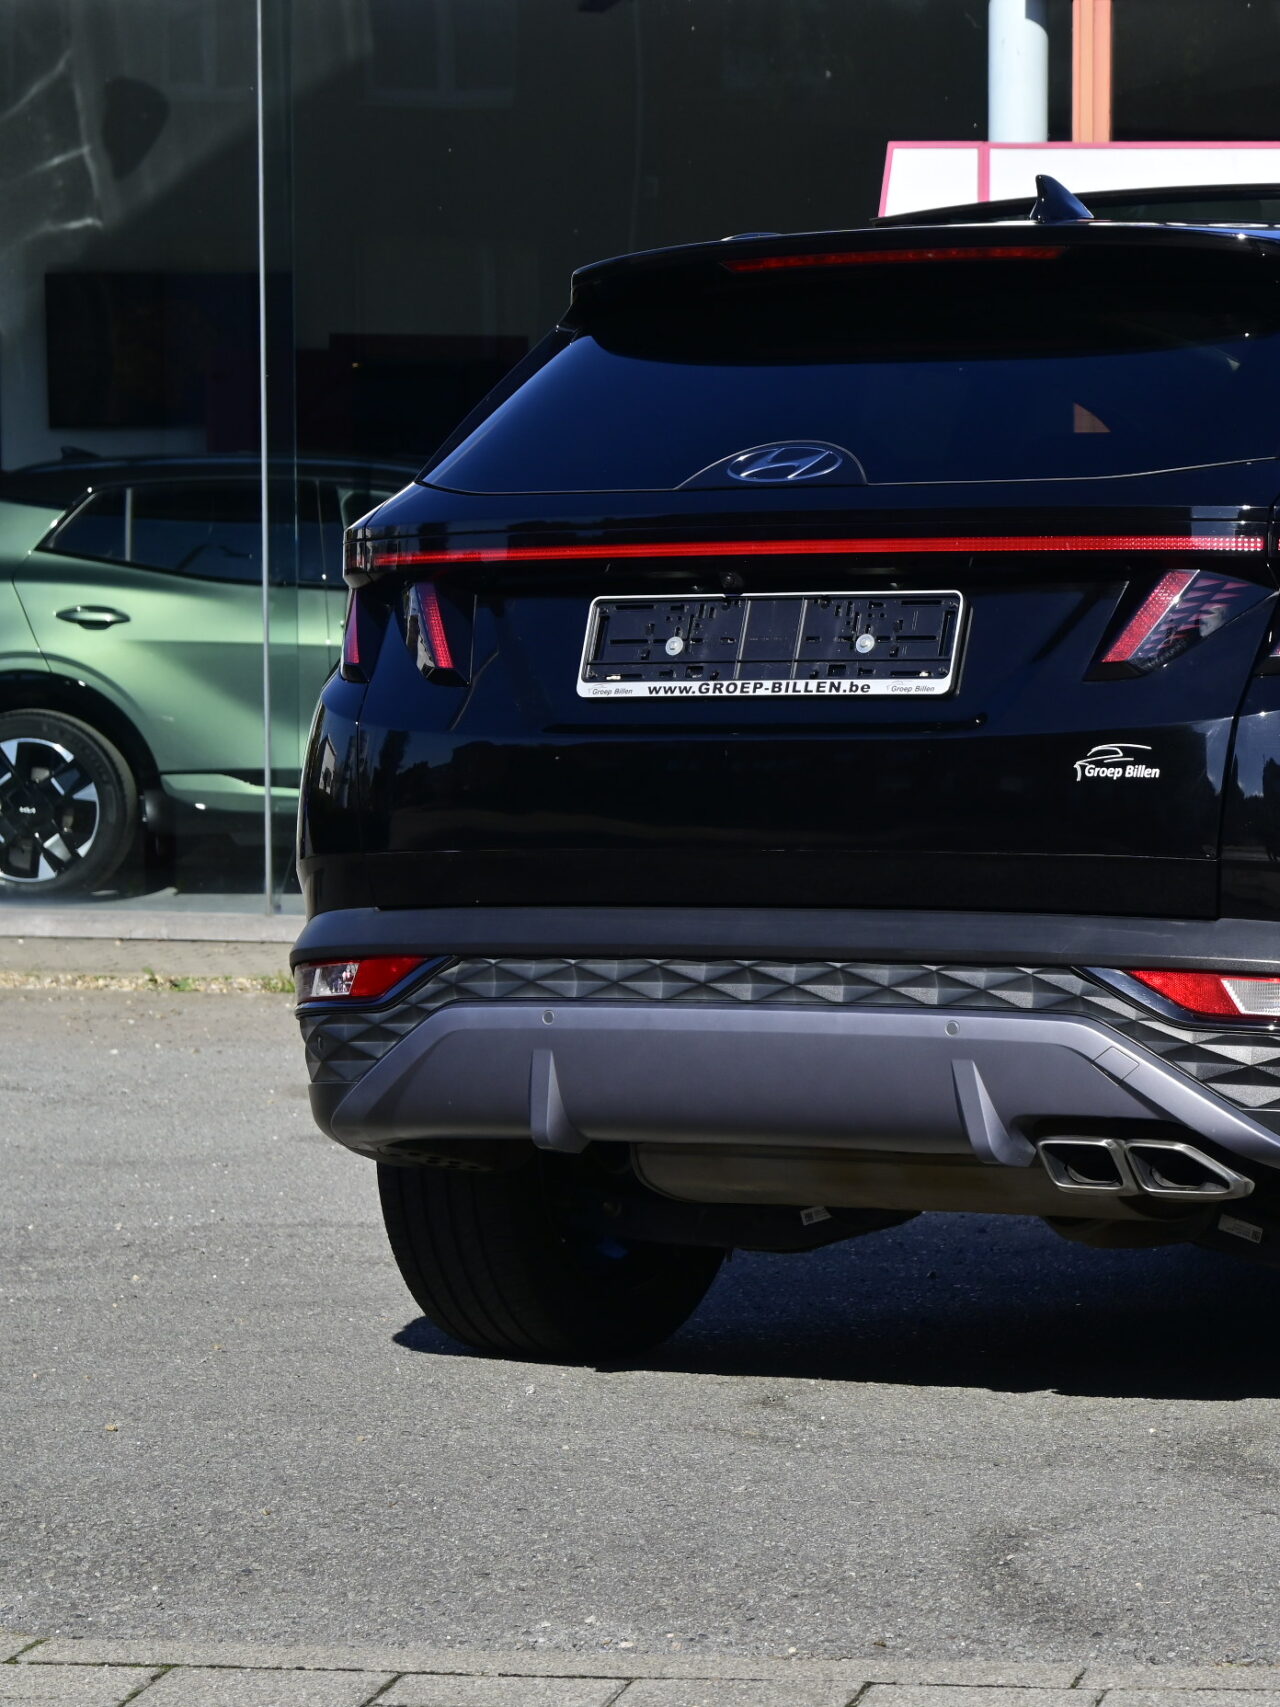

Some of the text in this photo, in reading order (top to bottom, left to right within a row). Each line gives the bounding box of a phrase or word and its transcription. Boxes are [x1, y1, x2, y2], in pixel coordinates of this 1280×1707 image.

[647, 681, 871, 695] www.GROEP-BILLEN.be
[1084, 764, 1161, 780] Groep Billen
